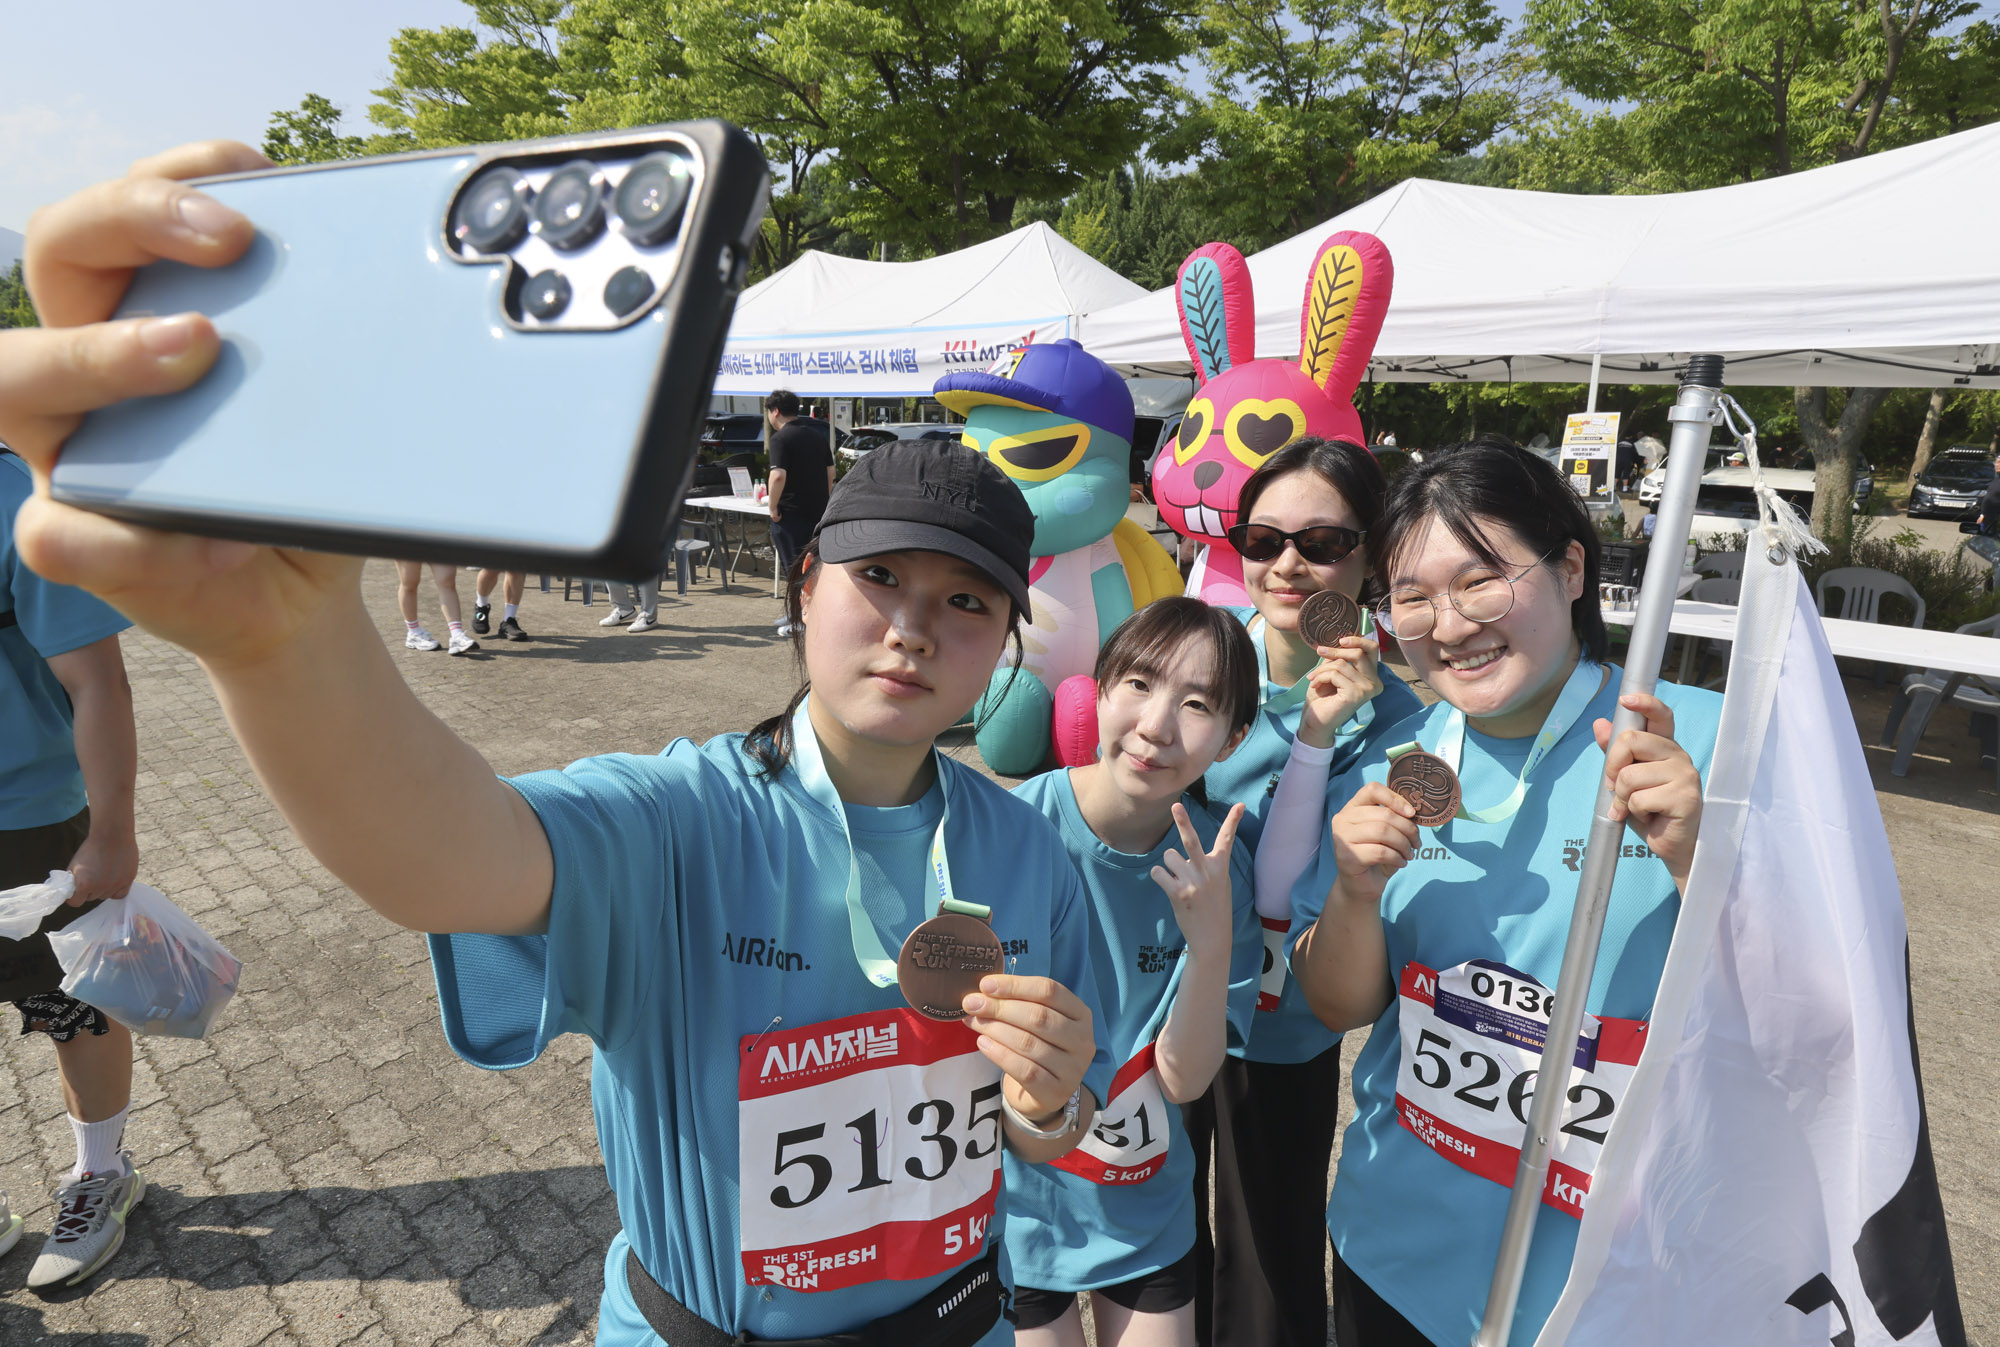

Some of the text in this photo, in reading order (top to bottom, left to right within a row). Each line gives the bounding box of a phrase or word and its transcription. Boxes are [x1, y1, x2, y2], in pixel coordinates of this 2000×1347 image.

[754, 352, 803, 376] 뇌파·맥파
[806, 351, 858, 375] 스트레스
[859, 349, 887, 374] 검사
[888, 348, 919, 373] 체험
[1564, 838, 1585, 847] THE
[917, 933, 936, 943] THE
[1139, 945, 1154, 953] THE
[760, 1022, 899, 1078] 시사저널
[760, 1056, 866, 1084] WEEKLY NEWSMAGAZINE
[1093, 1101, 1157, 1152] 51
[1405, 1103, 1435, 1125] THE 1ST
[770, 1081, 1000, 1209] 5135
[1102, 1166, 1152, 1181] 5 km
[944, 1224, 963, 1255] 5
[762, 1249, 815, 1265] THE 1ST
